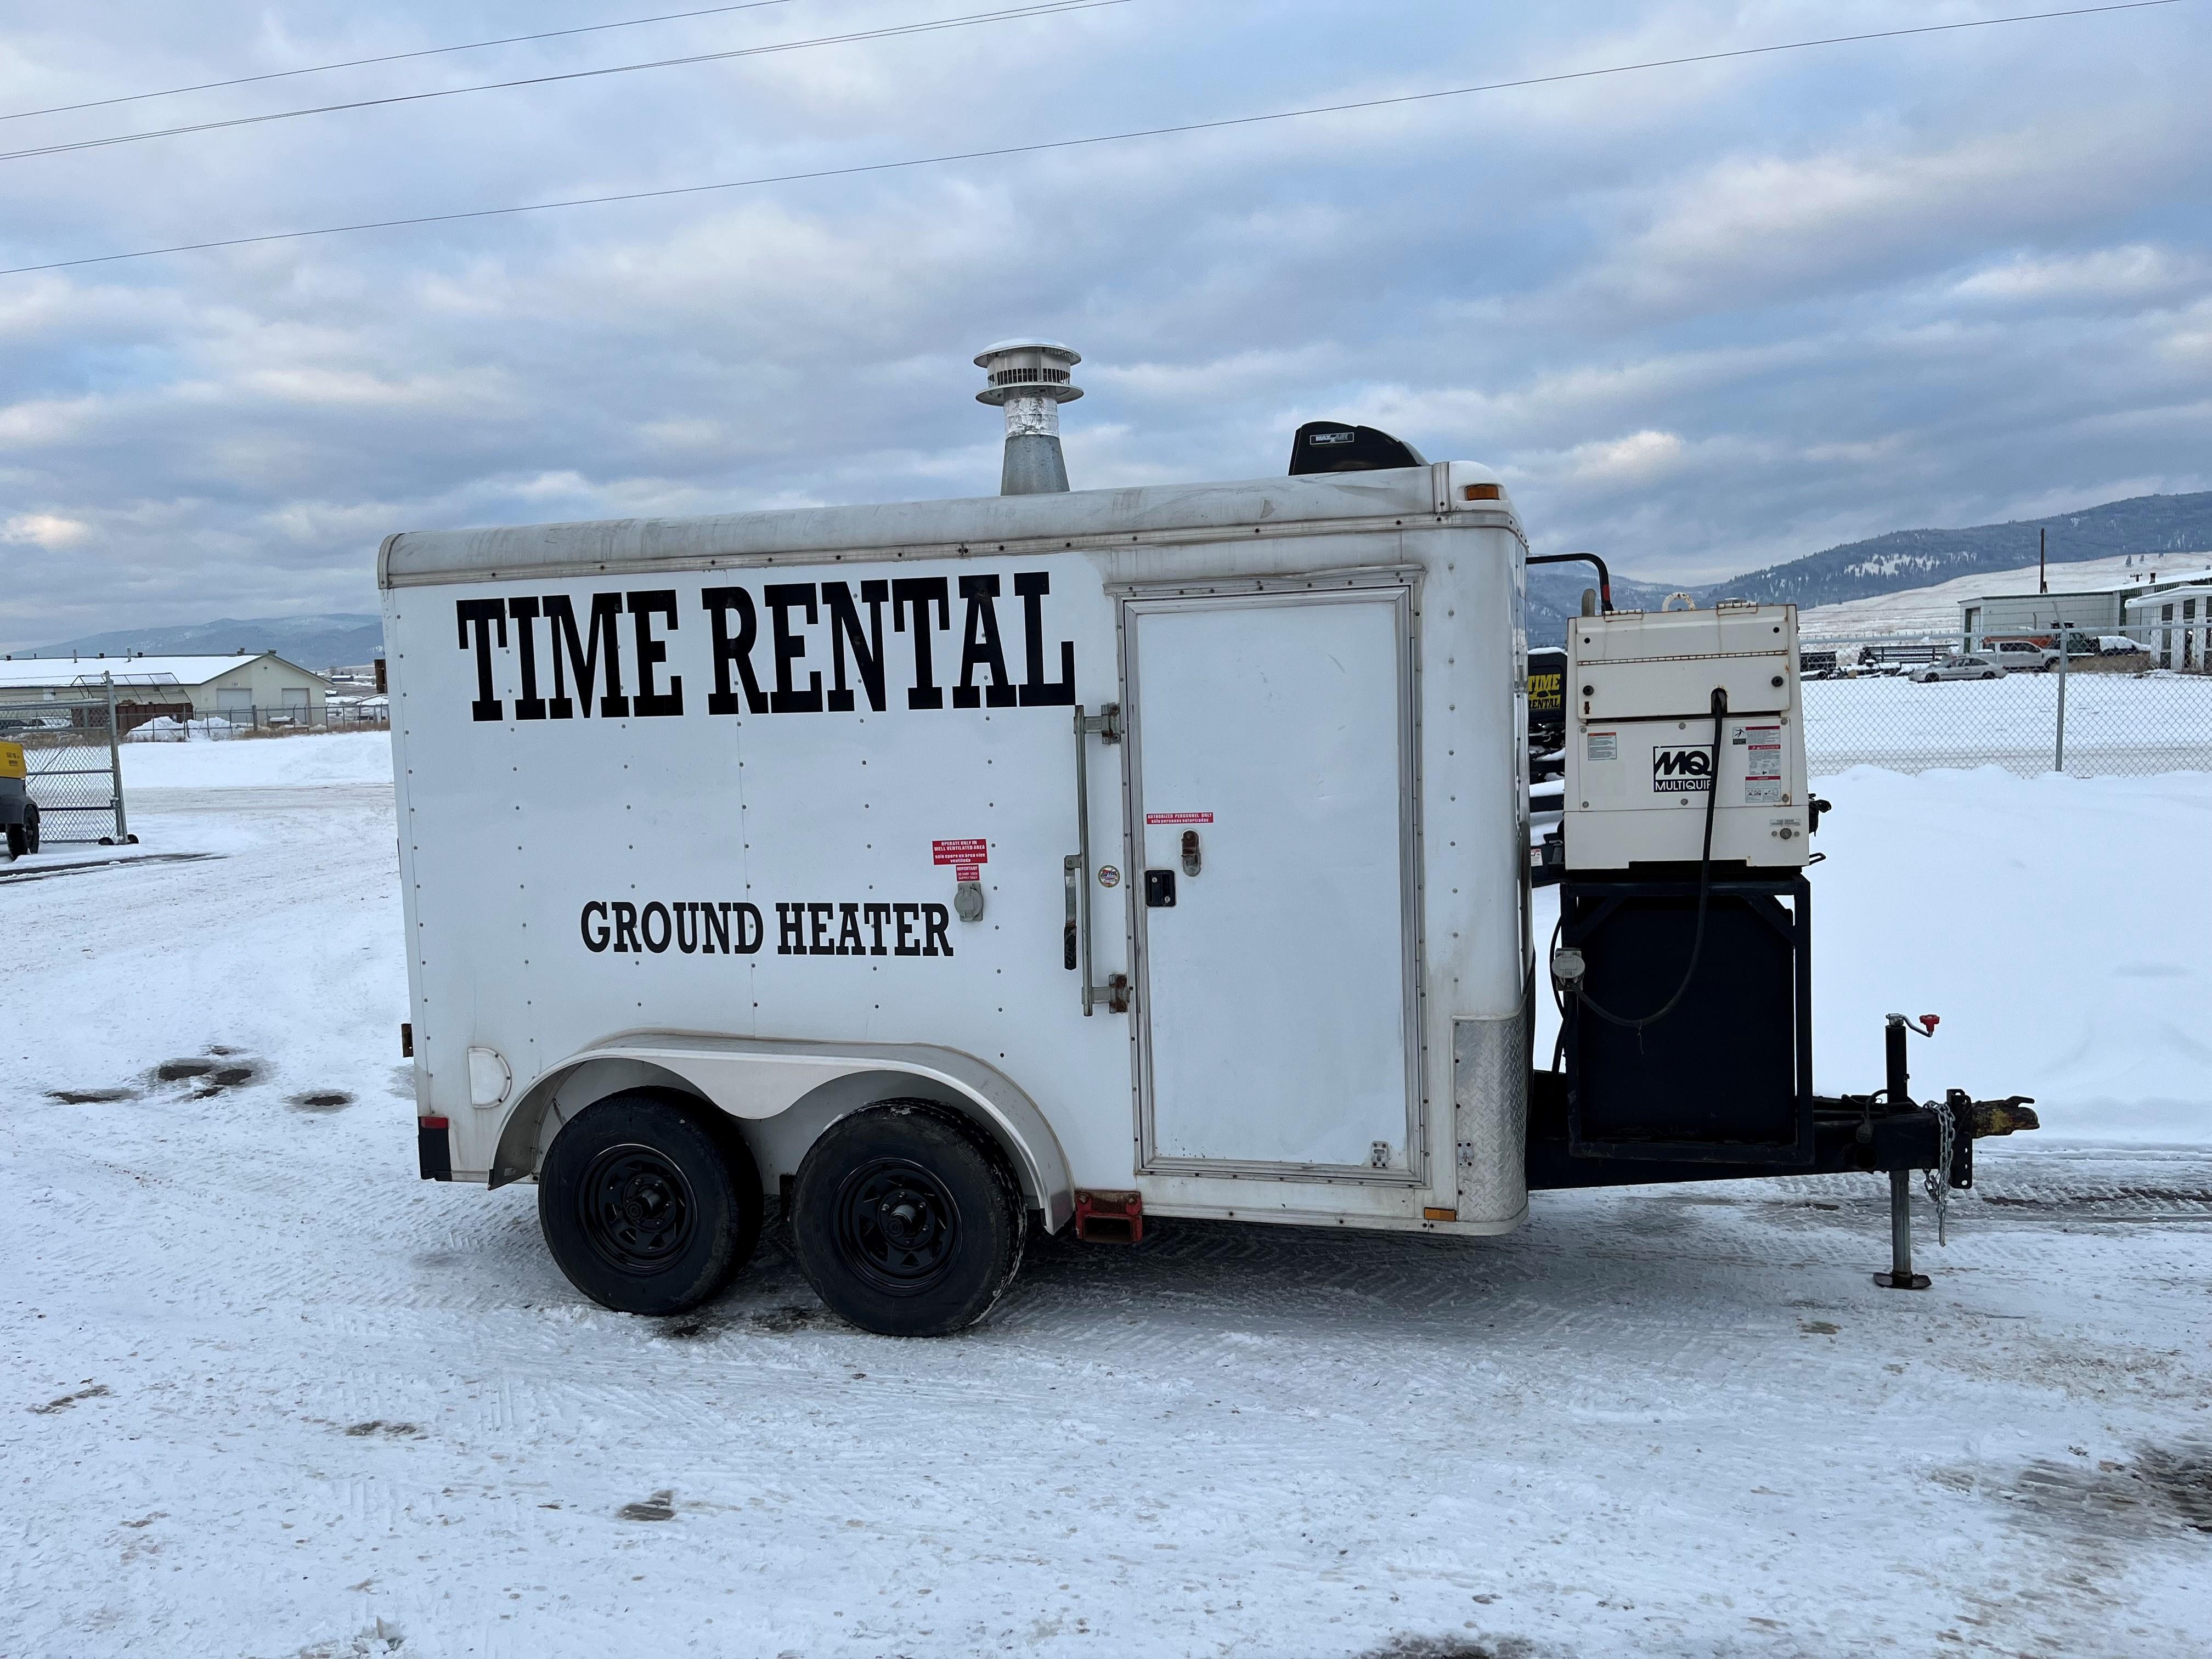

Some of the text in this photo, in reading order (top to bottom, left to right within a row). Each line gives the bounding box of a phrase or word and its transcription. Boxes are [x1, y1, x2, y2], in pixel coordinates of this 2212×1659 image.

[456, 572, 1073, 721] TIME RENTAL
[1528, 674, 1560, 691] TIME
[1655, 751, 1712, 775] MQ
[582, 901, 953, 956] GROUND HEATER
